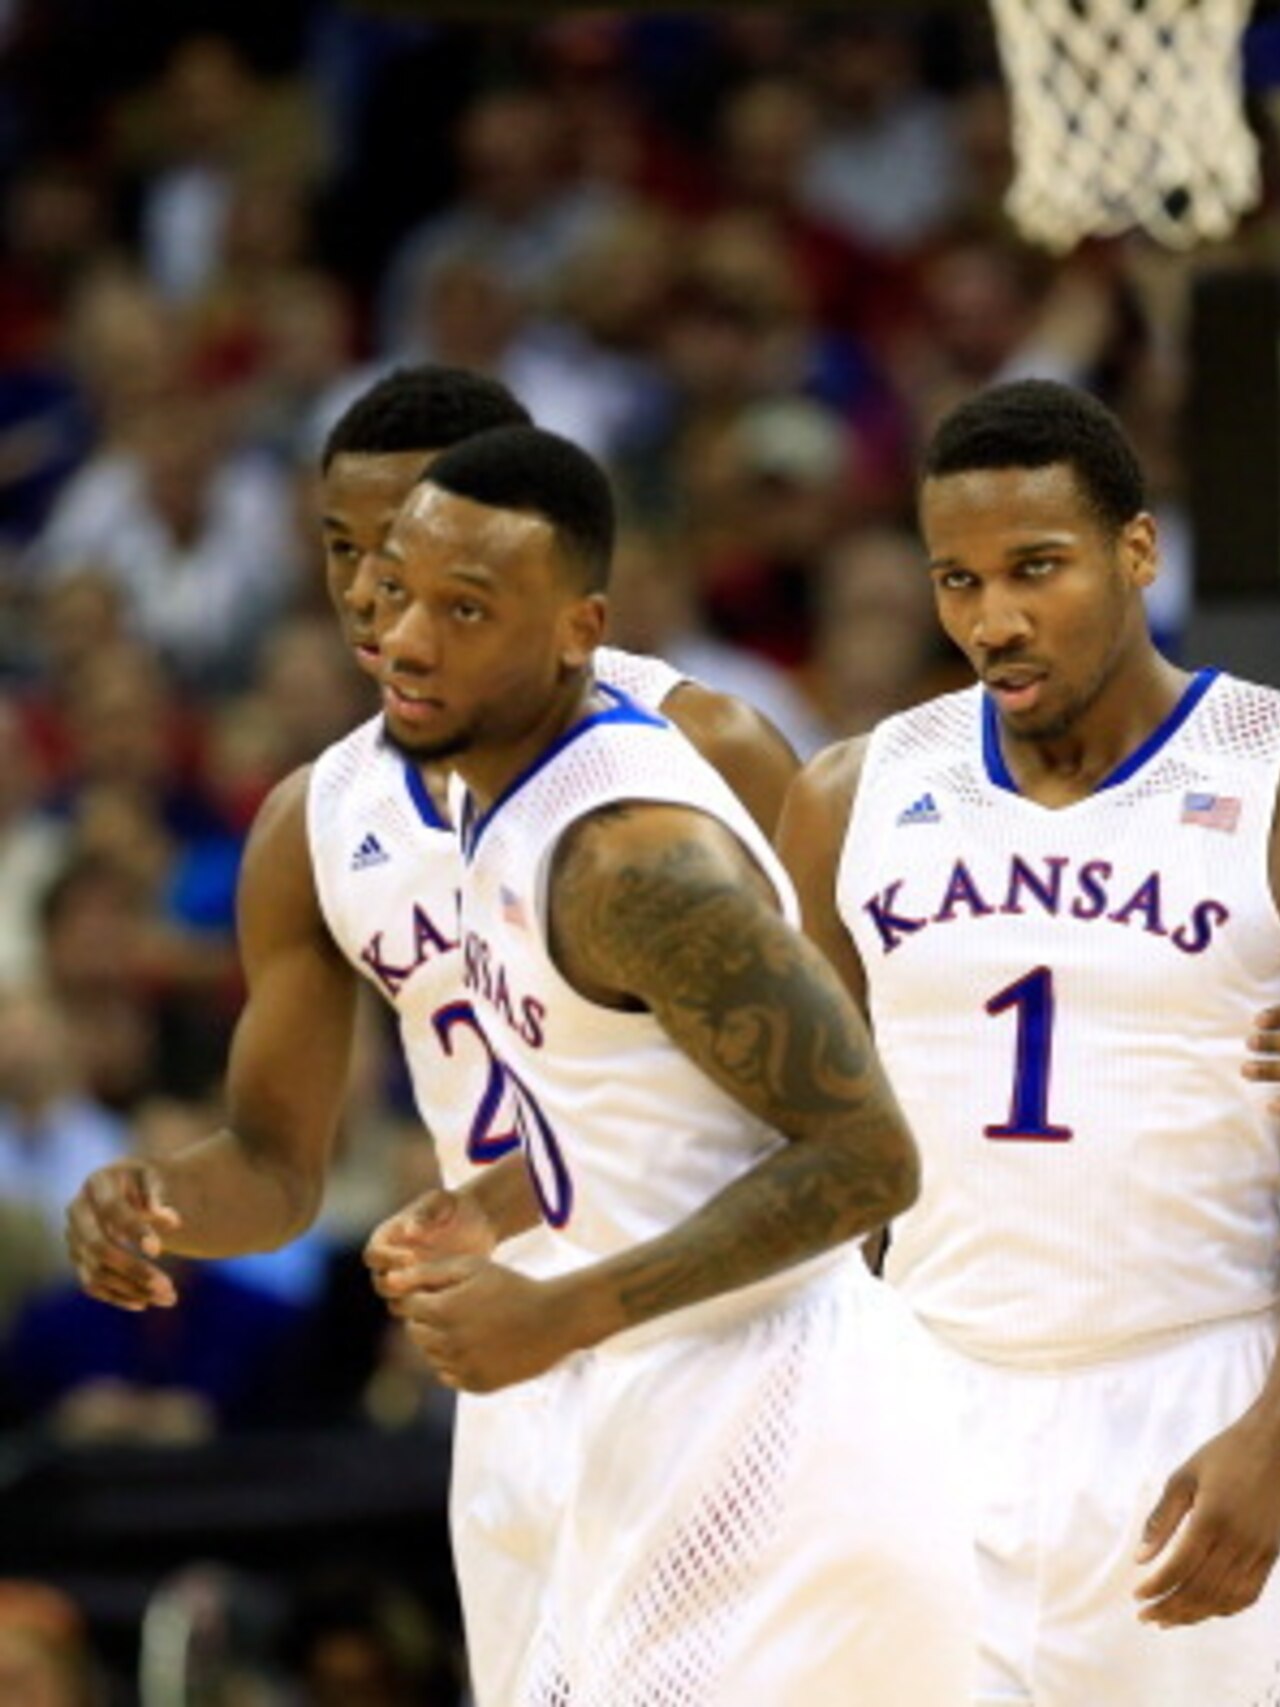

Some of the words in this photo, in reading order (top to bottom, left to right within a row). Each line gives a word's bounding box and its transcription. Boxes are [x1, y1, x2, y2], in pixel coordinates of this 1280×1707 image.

[863, 853, 1230, 955] KANSAS
[463, 931, 546, 1049] NSAS
[983, 965, 1073, 1142] 1
